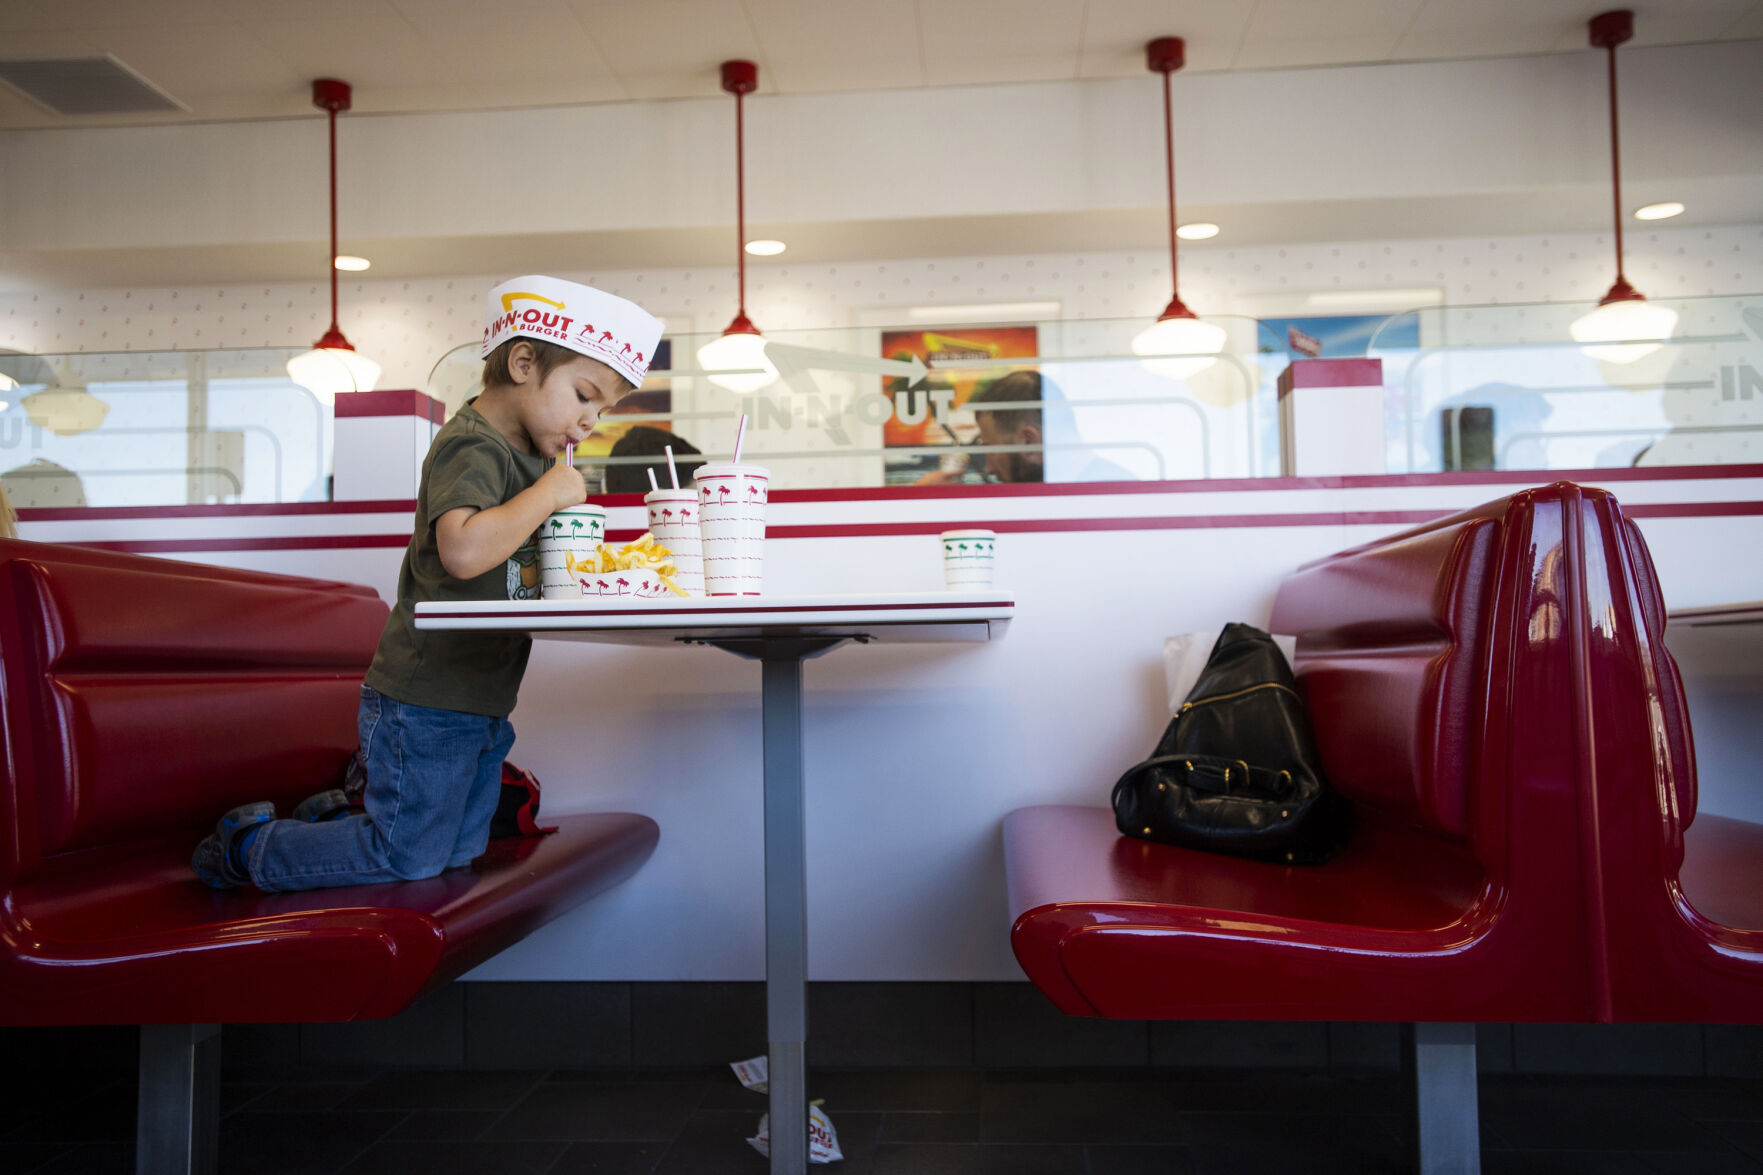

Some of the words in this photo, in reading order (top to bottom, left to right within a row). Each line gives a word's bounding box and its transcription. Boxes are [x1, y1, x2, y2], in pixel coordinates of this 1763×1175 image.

[491, 308, 574, 339] IN-N-OUT
[519, 323, 568, 341] BURGER
[740, 389, 955, 431] IN-N-OUT
